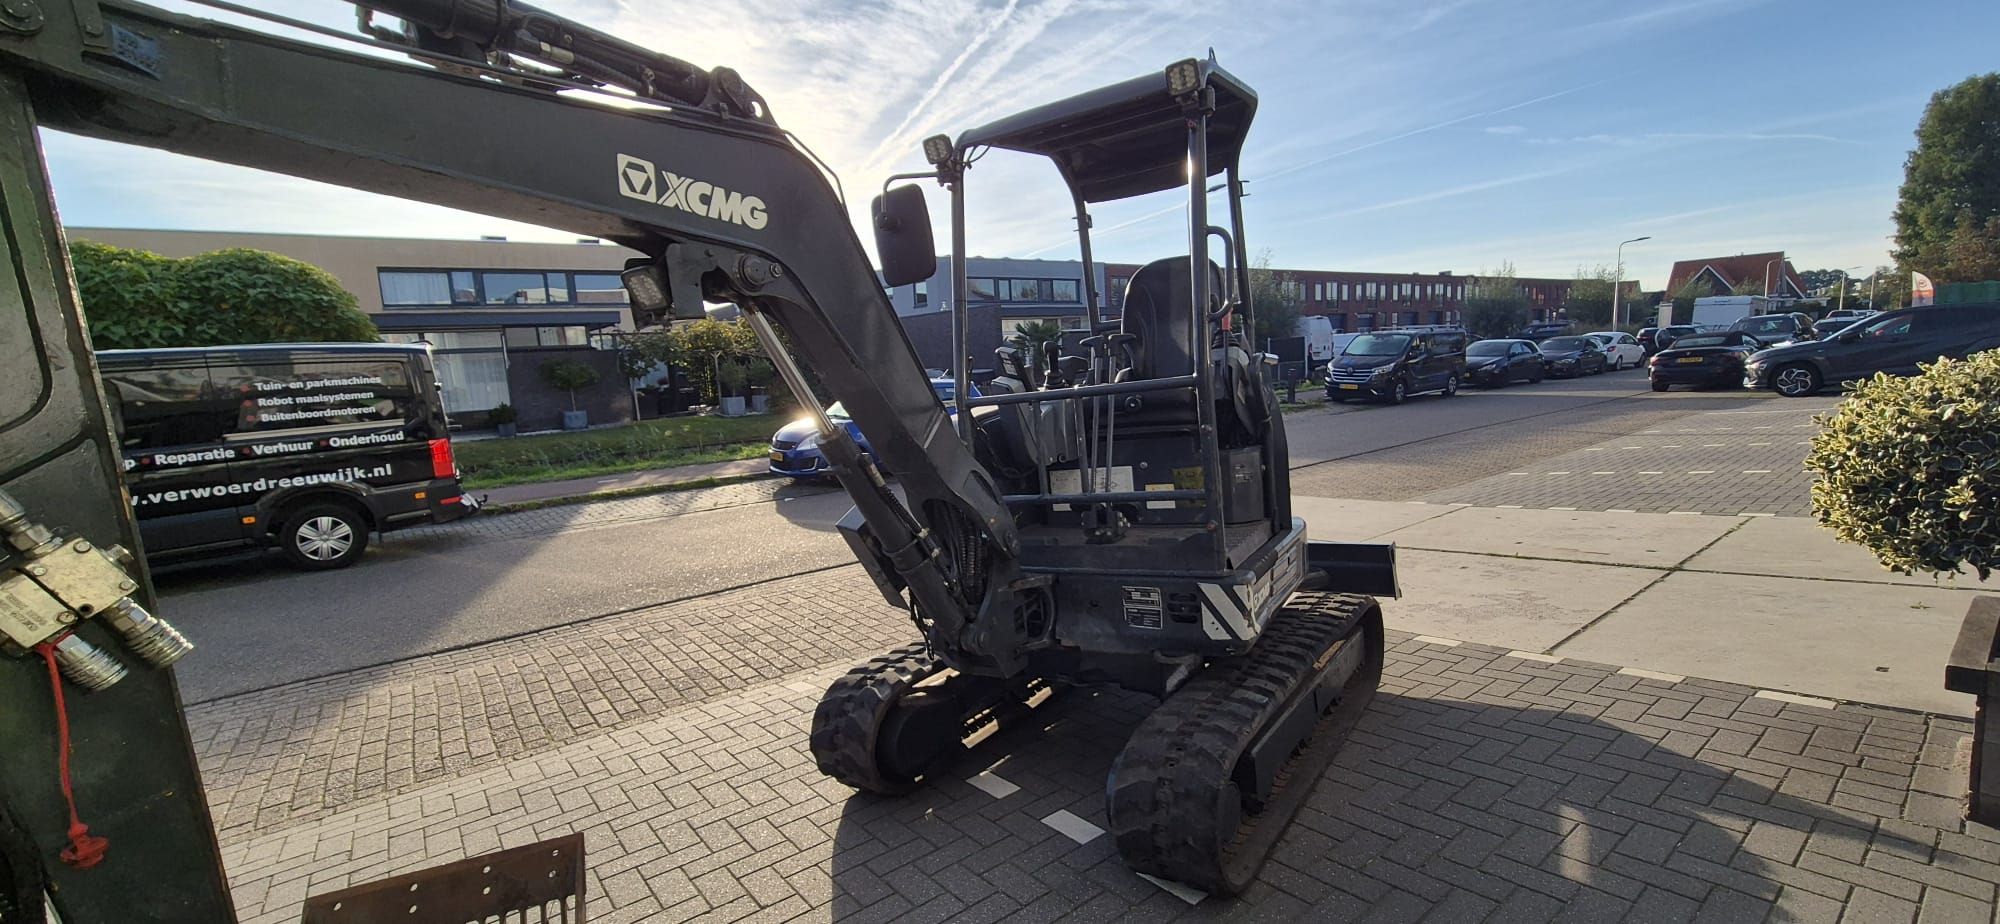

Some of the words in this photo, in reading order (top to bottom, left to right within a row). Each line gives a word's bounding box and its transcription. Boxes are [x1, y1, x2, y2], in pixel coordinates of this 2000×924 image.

[657, 170, 768, 230] XCMG
[288, 380, 304, 389] en
[304, 376, 382, 390] parkmachines
[258, 396, 294, 406] Robot
[261, 406, 376, 422] Buitenboordmotoren
[154, 448, 236, 465] Reparatie
[252, 441, 314, 455] Verhuur
[329, 431, 405, 447] Onderhoud
